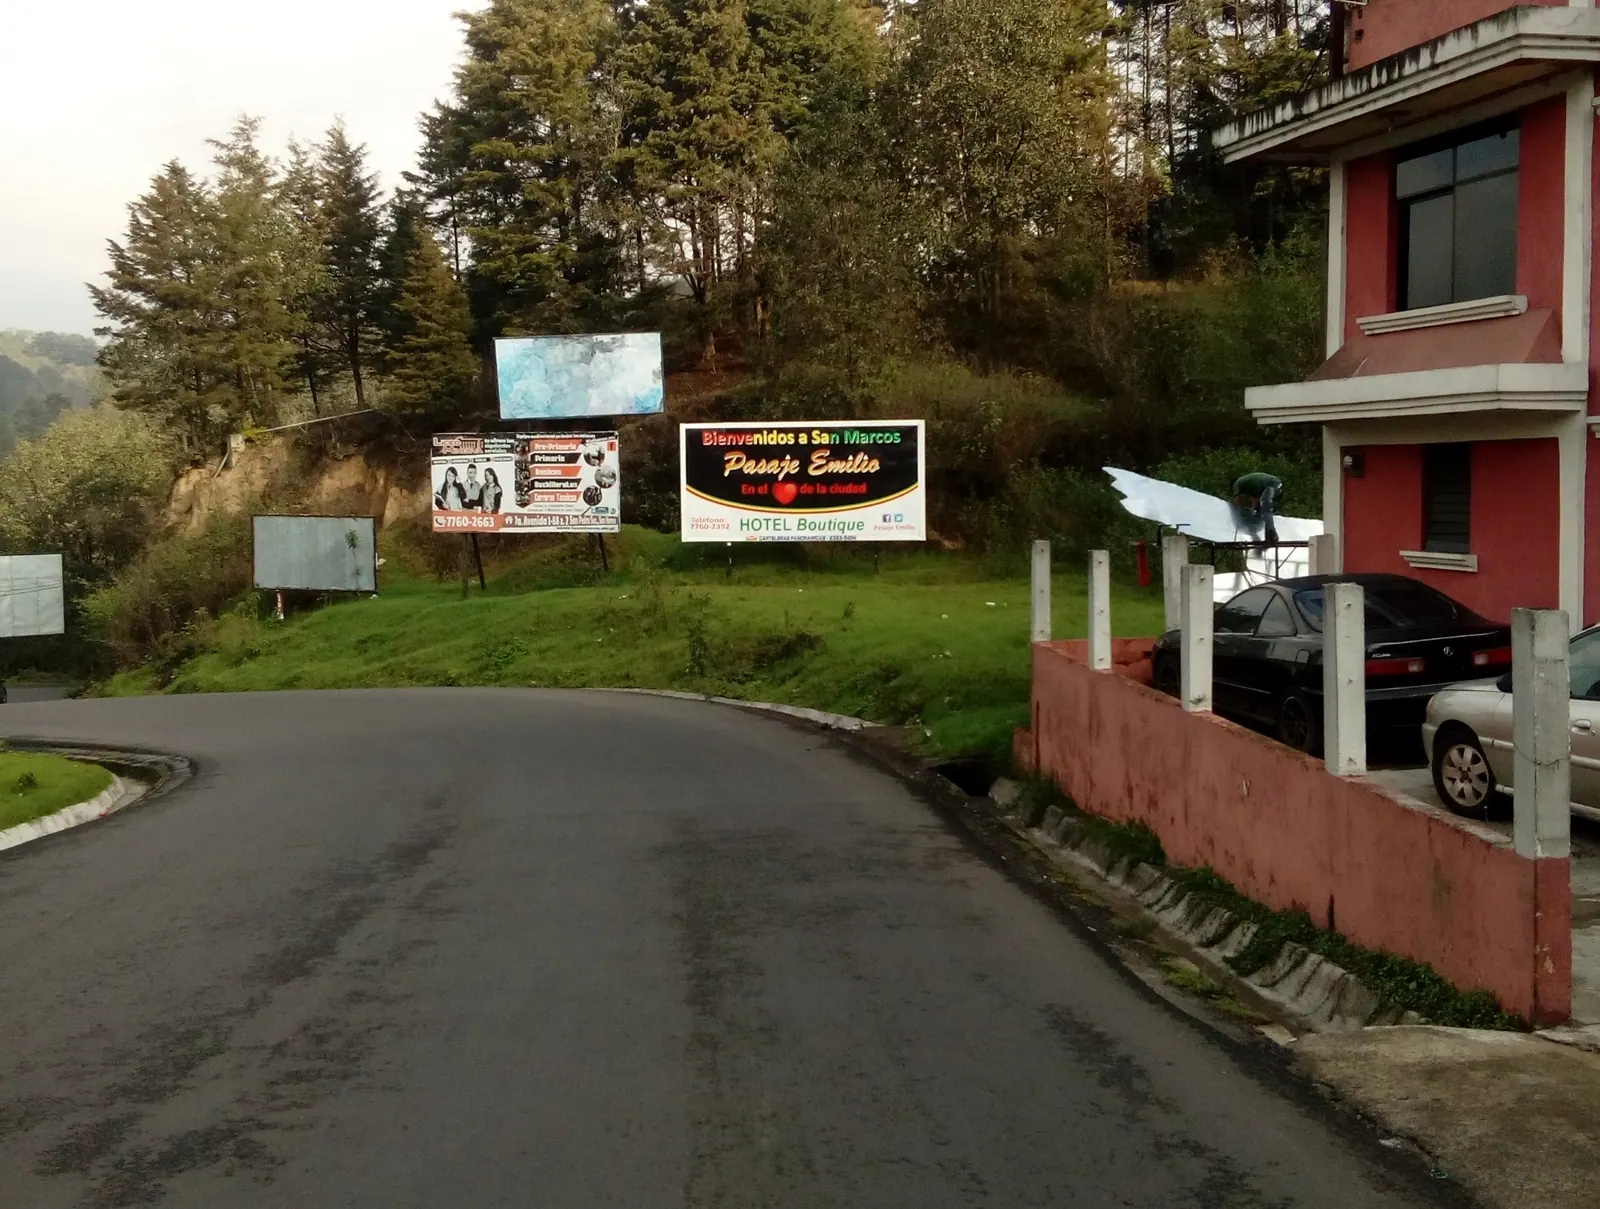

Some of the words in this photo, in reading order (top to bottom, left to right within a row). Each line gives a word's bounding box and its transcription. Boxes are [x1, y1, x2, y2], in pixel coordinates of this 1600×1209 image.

[702, 431, 794, 446] Bienvenidos
[799, 434, 807, 445] a
[811, 430, 839, 445] San
[844, 430, 901, 445] Marcos
[535, 454, 565, 462] Primaria
[724, 451, 800, 480] Pasaje
[808, 449, 880, 476] Emilio
[741, 484, 755, 495] En
[757, 484, 768, 495] el
[800, 483, 814, 494] de
[817, 483, 826, 494] la
[829, 483, 867, 494] ciudad
[446, 516, 495, 527] 7760-2663
[524, 515, 547, 526] Avenida
[740, 518, 791, 532] HOTEL
[797, 518, 865, 535] Boutique
